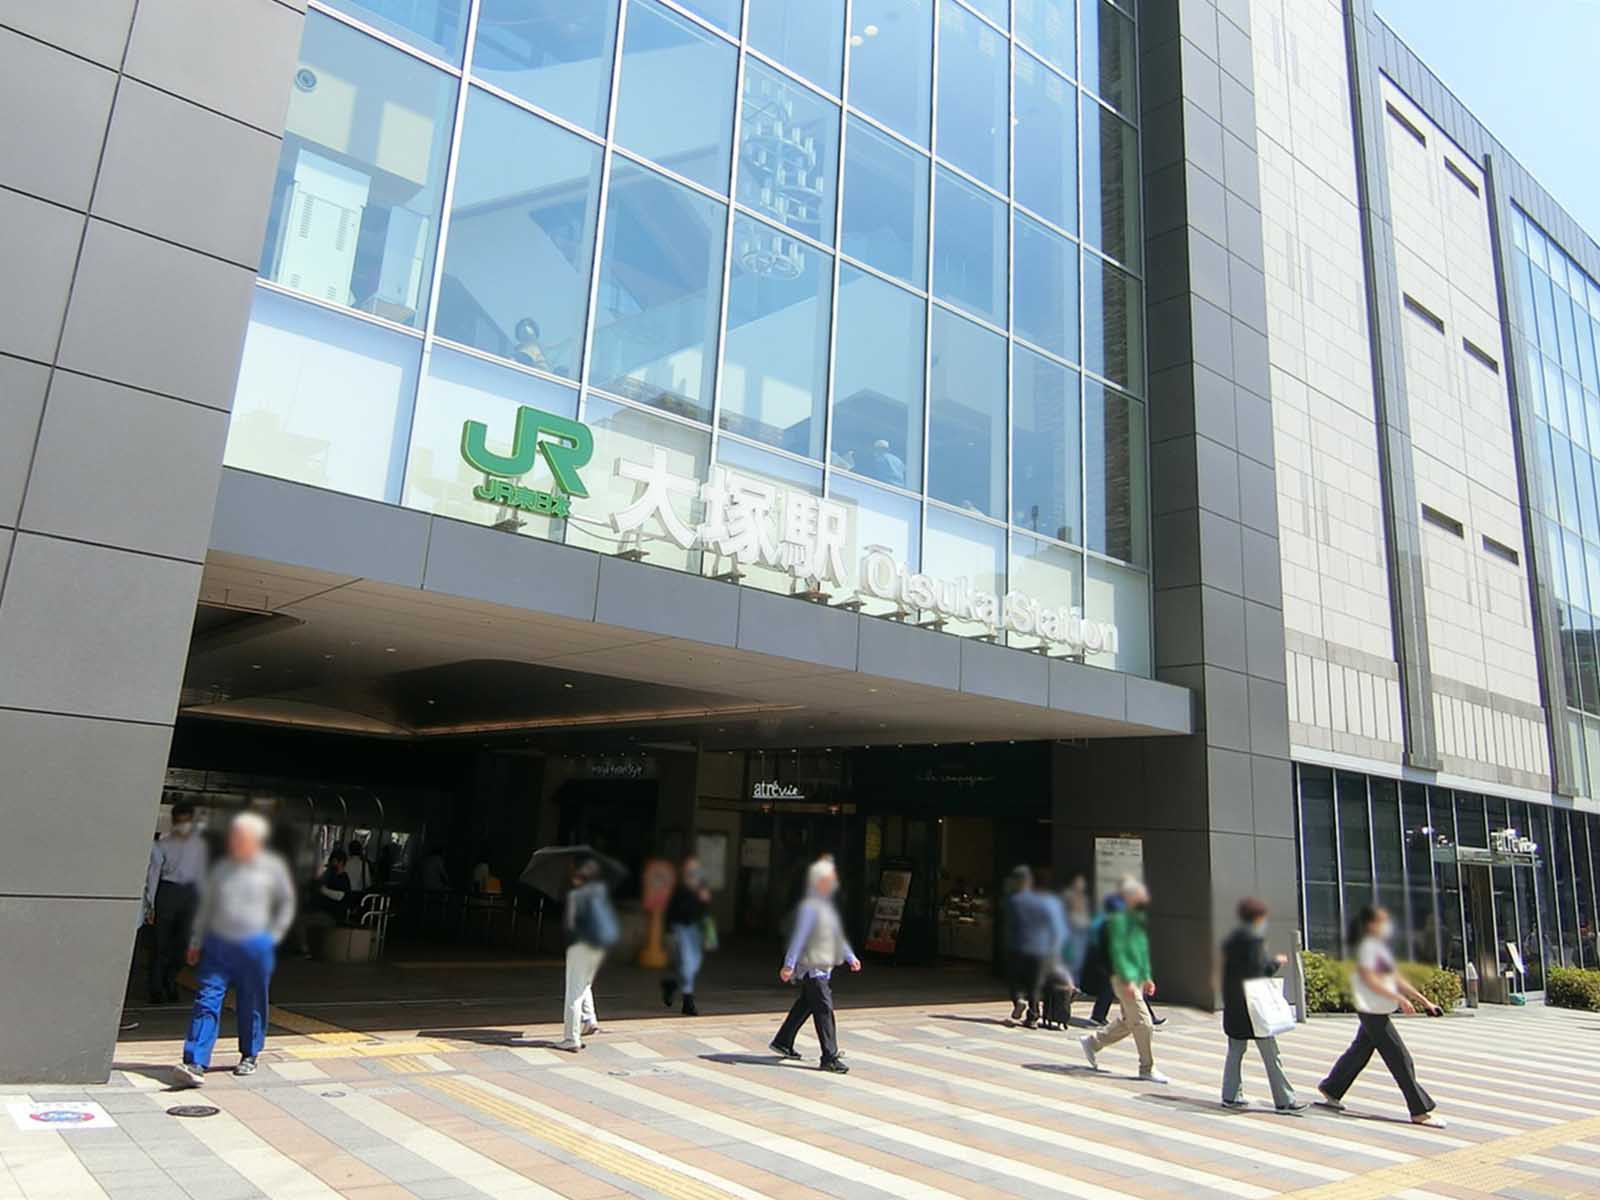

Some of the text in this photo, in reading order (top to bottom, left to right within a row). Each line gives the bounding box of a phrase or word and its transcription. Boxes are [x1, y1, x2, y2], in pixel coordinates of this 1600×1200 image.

[462, 406, 593, 498] JR
[473, 479, 572, 518] JR東日本
[611, 448, 849, 587] 大塚駅
[1004, 590, 1119, 654] Station
